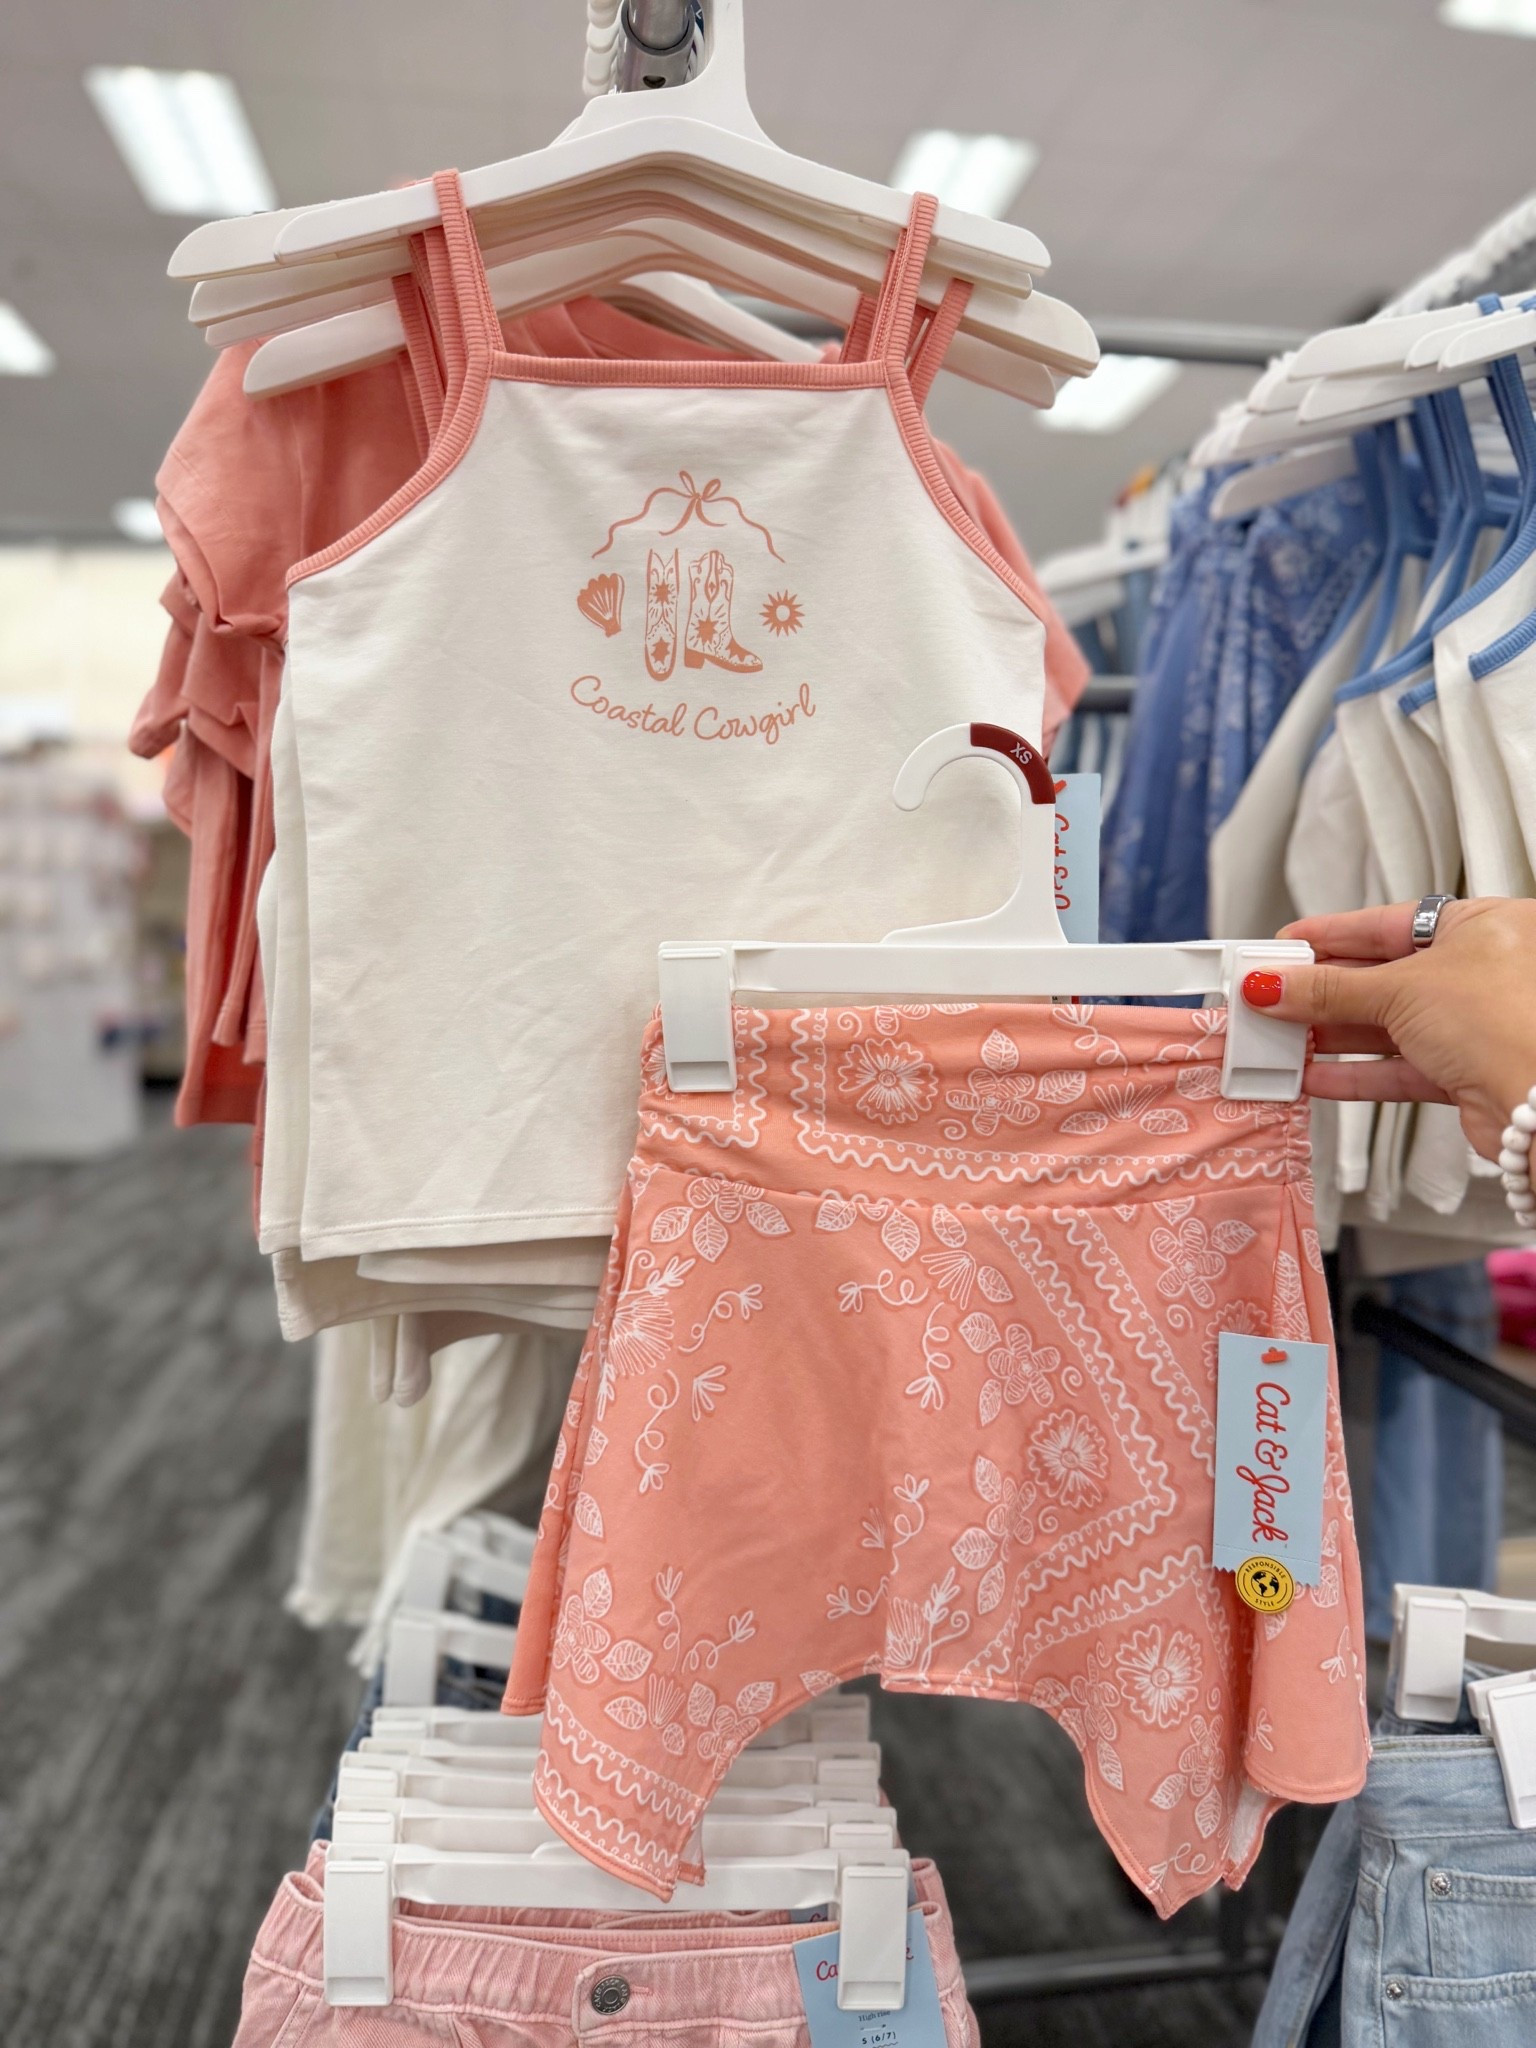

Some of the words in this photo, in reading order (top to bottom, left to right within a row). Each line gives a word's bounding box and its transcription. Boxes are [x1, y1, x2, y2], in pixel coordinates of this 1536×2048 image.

[570, 675, 688, 737] Coastal
[694, 683, 816, 745] Cowgirl
[1009, 741, 1033, 765] XS
[1256, 1382, 1291, 1433] Cat
[1255, 1439, 1288, 1471] &
[1236, 1465, 1290, 1543] Jack
[1245, 1561, 1287, 1579] RESPONSIBLE
[1255, 1598, 1274, 1607] STYLE
[816, 1960, 839, 1981] Ca
[858, 2012, 877, 2022] High
[871, 2031, 896, 2044] (6/7)
